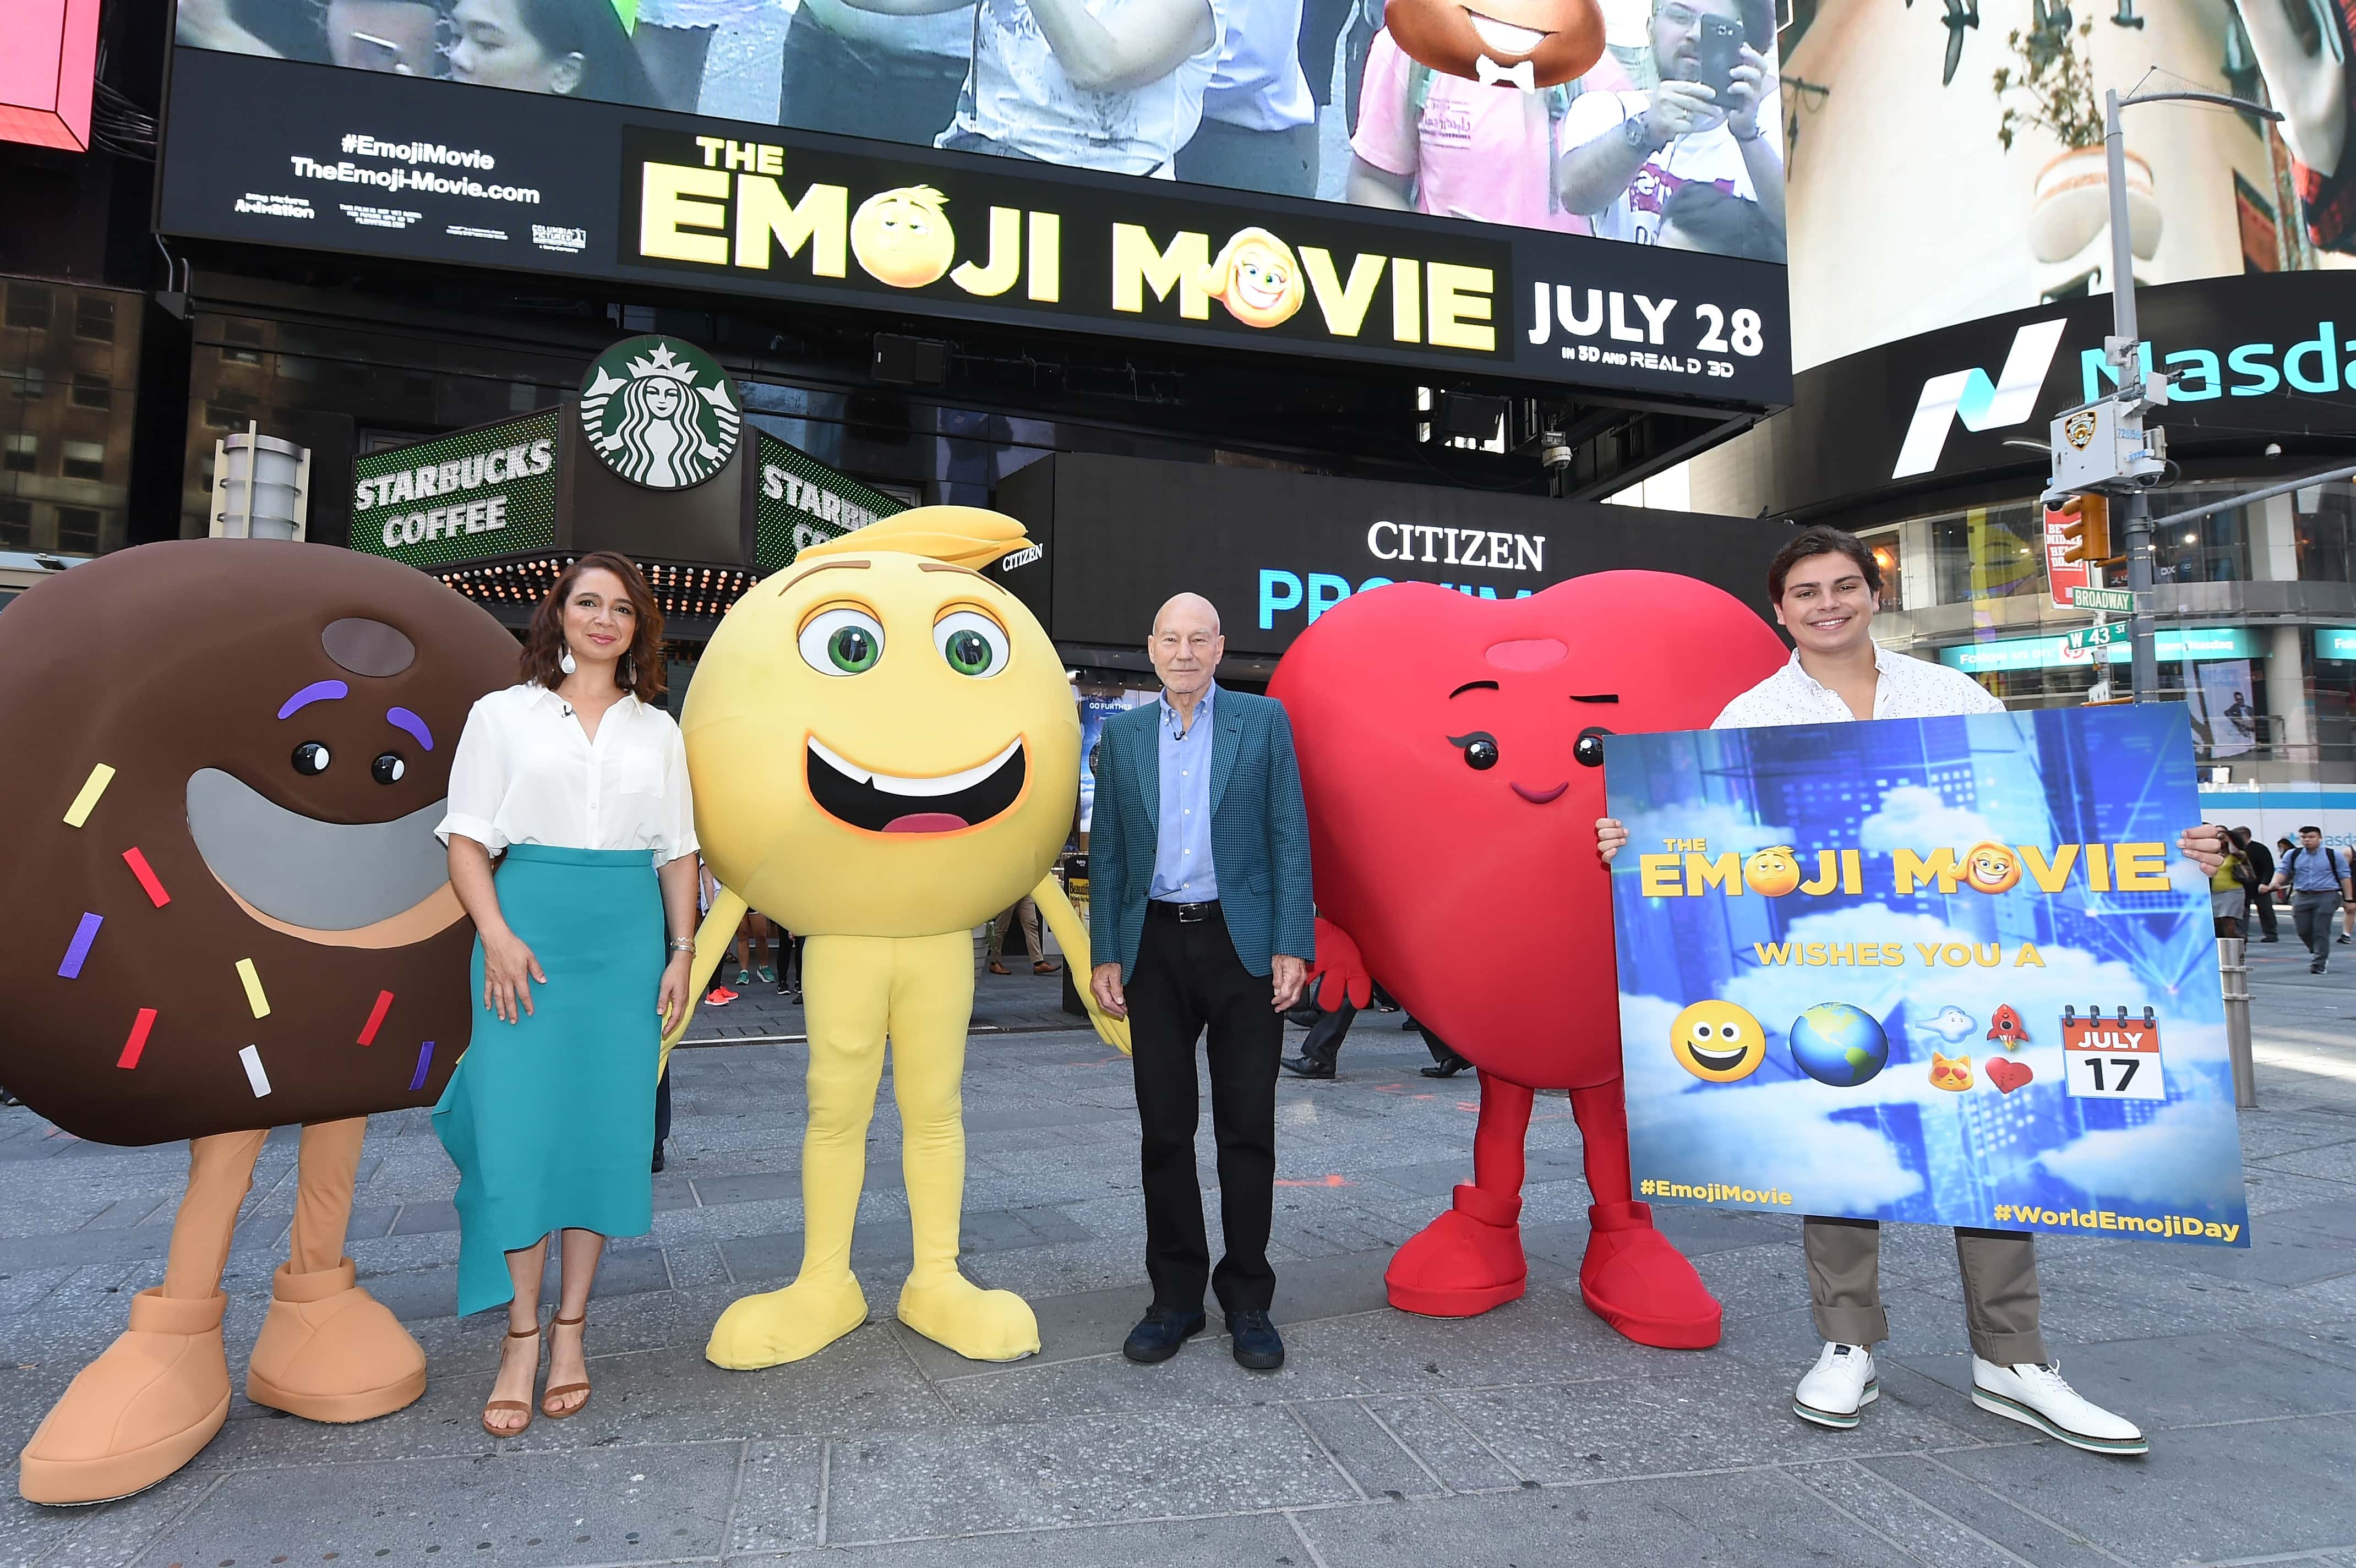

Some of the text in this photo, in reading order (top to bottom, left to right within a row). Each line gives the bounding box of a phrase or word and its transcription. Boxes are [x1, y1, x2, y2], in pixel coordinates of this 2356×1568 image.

[341, 133, 495, 170] #EmojiMovie
[695, 136, 783, 175] THE
[291, 156, 541, 204] TheEmoji-Movie.com
[640, 160, 1496, 352] EMOJI MOVIE
[1528, 281, 1764, 357] JULY 28
[1561, 346, 1575, 360] IN
[1578, 345, 1600, 363] 3D
[1602, 352, 1628, 366] AND
[1707, 360, 1735, 378] 3D
[2081, 321, 2356, 405] Nasd
[356, 439, 551, 511] STARBUCKS
[383, 495, 507, 548] COFFEE
[1002, 543, 1043, 572] CITIZEN
[1367, 521, 1546, 572] CITIZEN
[2075, 589, 2129, 610] BROADWAY
[2070, 624, 2126, 649] W 43 ST
[1960, 652, 2008, 665] Follow
[1663, 838, 1707, 852] THE
[1640, 841, 2171, 897] EMOJI MOVIE
[1753, 942, 2046, 968] WISHES YOU A
[2077, 1031, 2144, 1049] JULY
[2084, 1058, 2140, 1091] 17
[1640, 1179, 1793, 1205] #EmojiMovie
[1994, 1204, 2240, 1242] #WorldEmojiDay
